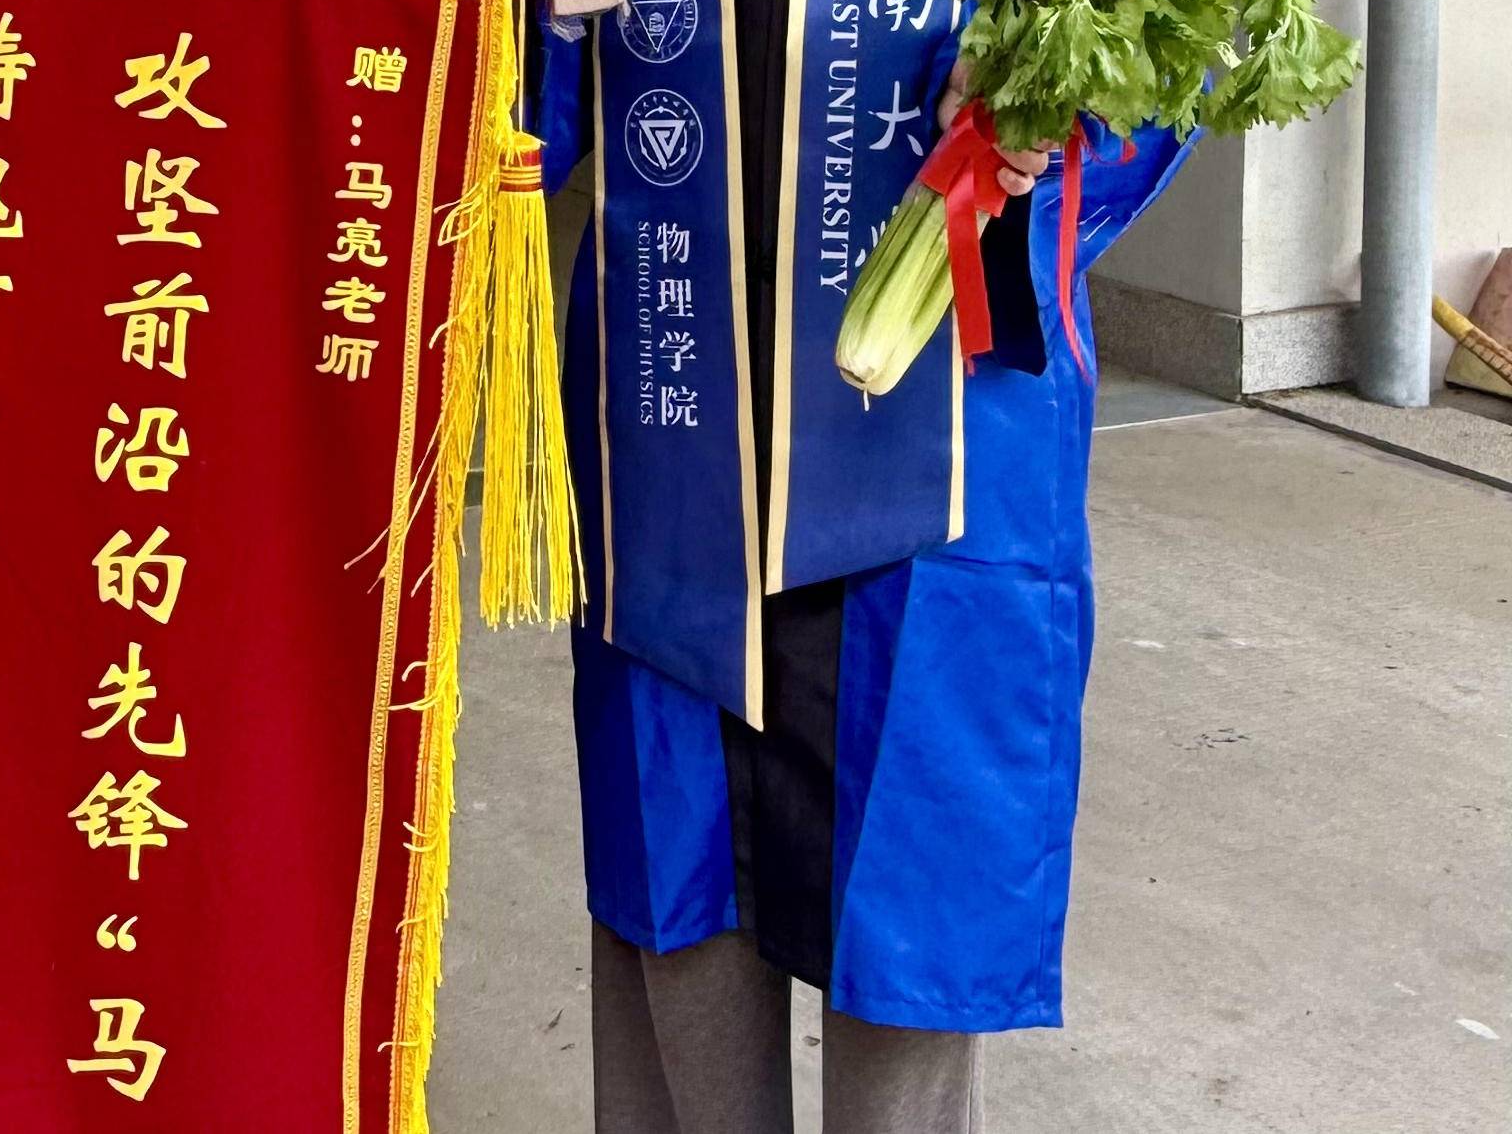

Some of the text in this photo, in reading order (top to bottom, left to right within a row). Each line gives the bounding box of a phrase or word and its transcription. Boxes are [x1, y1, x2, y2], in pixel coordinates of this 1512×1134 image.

[819, 58, 858, 296] UNIVERSITY
[637, 220, 655, 426] SCHOOL OF PHYSICS
[656, 221, 700, 428] 物理学院
